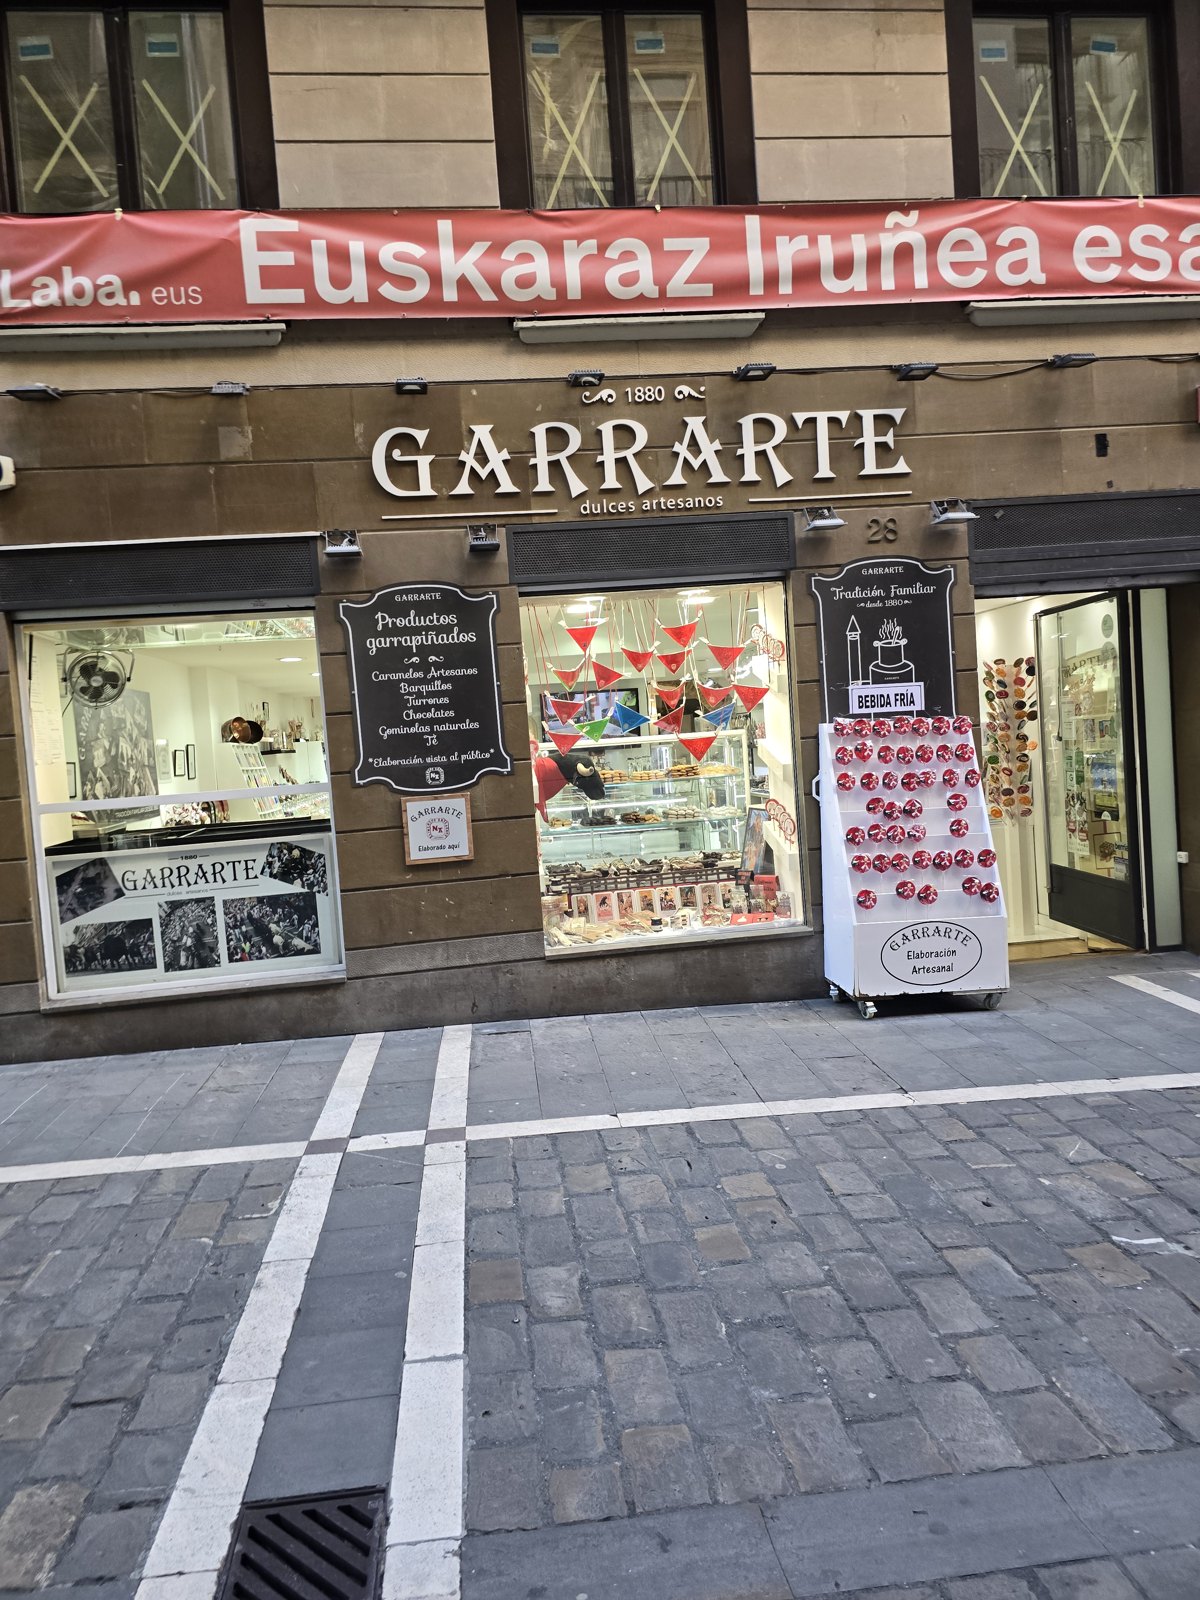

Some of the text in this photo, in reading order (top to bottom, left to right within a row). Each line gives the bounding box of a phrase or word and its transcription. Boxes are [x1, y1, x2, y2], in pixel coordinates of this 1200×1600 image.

[239, 219, 714, 305] Euskaraz
[745, 210, 1046, 296] Iruñea
[1, 266, 203, 308] Laba. eus
[625, 385, 665, 403] 1880
[371, 408, 912, 498] GARRARTE
[580, 496, 723, 514] dulces artesanos
[867, 517, 898, 544] 28
[861, 566, 904, 575] GARRARTE
[395, 592, 441, 601] GARRARTE
[831, 582, 936, 600] Tradición Familiar
[866, 599, 903, 608] desde 1880
[375, 610, 457, 631] Productos
[366, 627, 477, 655] garrapiñados
[372, 666, 478, 681] Caramelos Artesanos
[400, 680, 452, 695] Barquillos
[404, 694, 449, 707] Turrones
[858, 689, 915, 709] BEBIDA FRÍA
[403, 708, 454, 720] Chocolates
[379, 719, 479, 739] Gominolas naturales
[423, 734, 438, 746] Té
[426, 755, 447, 763] vista
[450, 752, 459, 761] al
[410, 806, 463, 822] GARRARTE
[418, 841, 460, 852] Elaborado aquí
[121, 858, 259, 891] GARRARTE
[889, 926, 972, 951] GARRARTE
[907, 947, 957, 960] Elaboración
[911, 963, 954, 975] Artesanal
